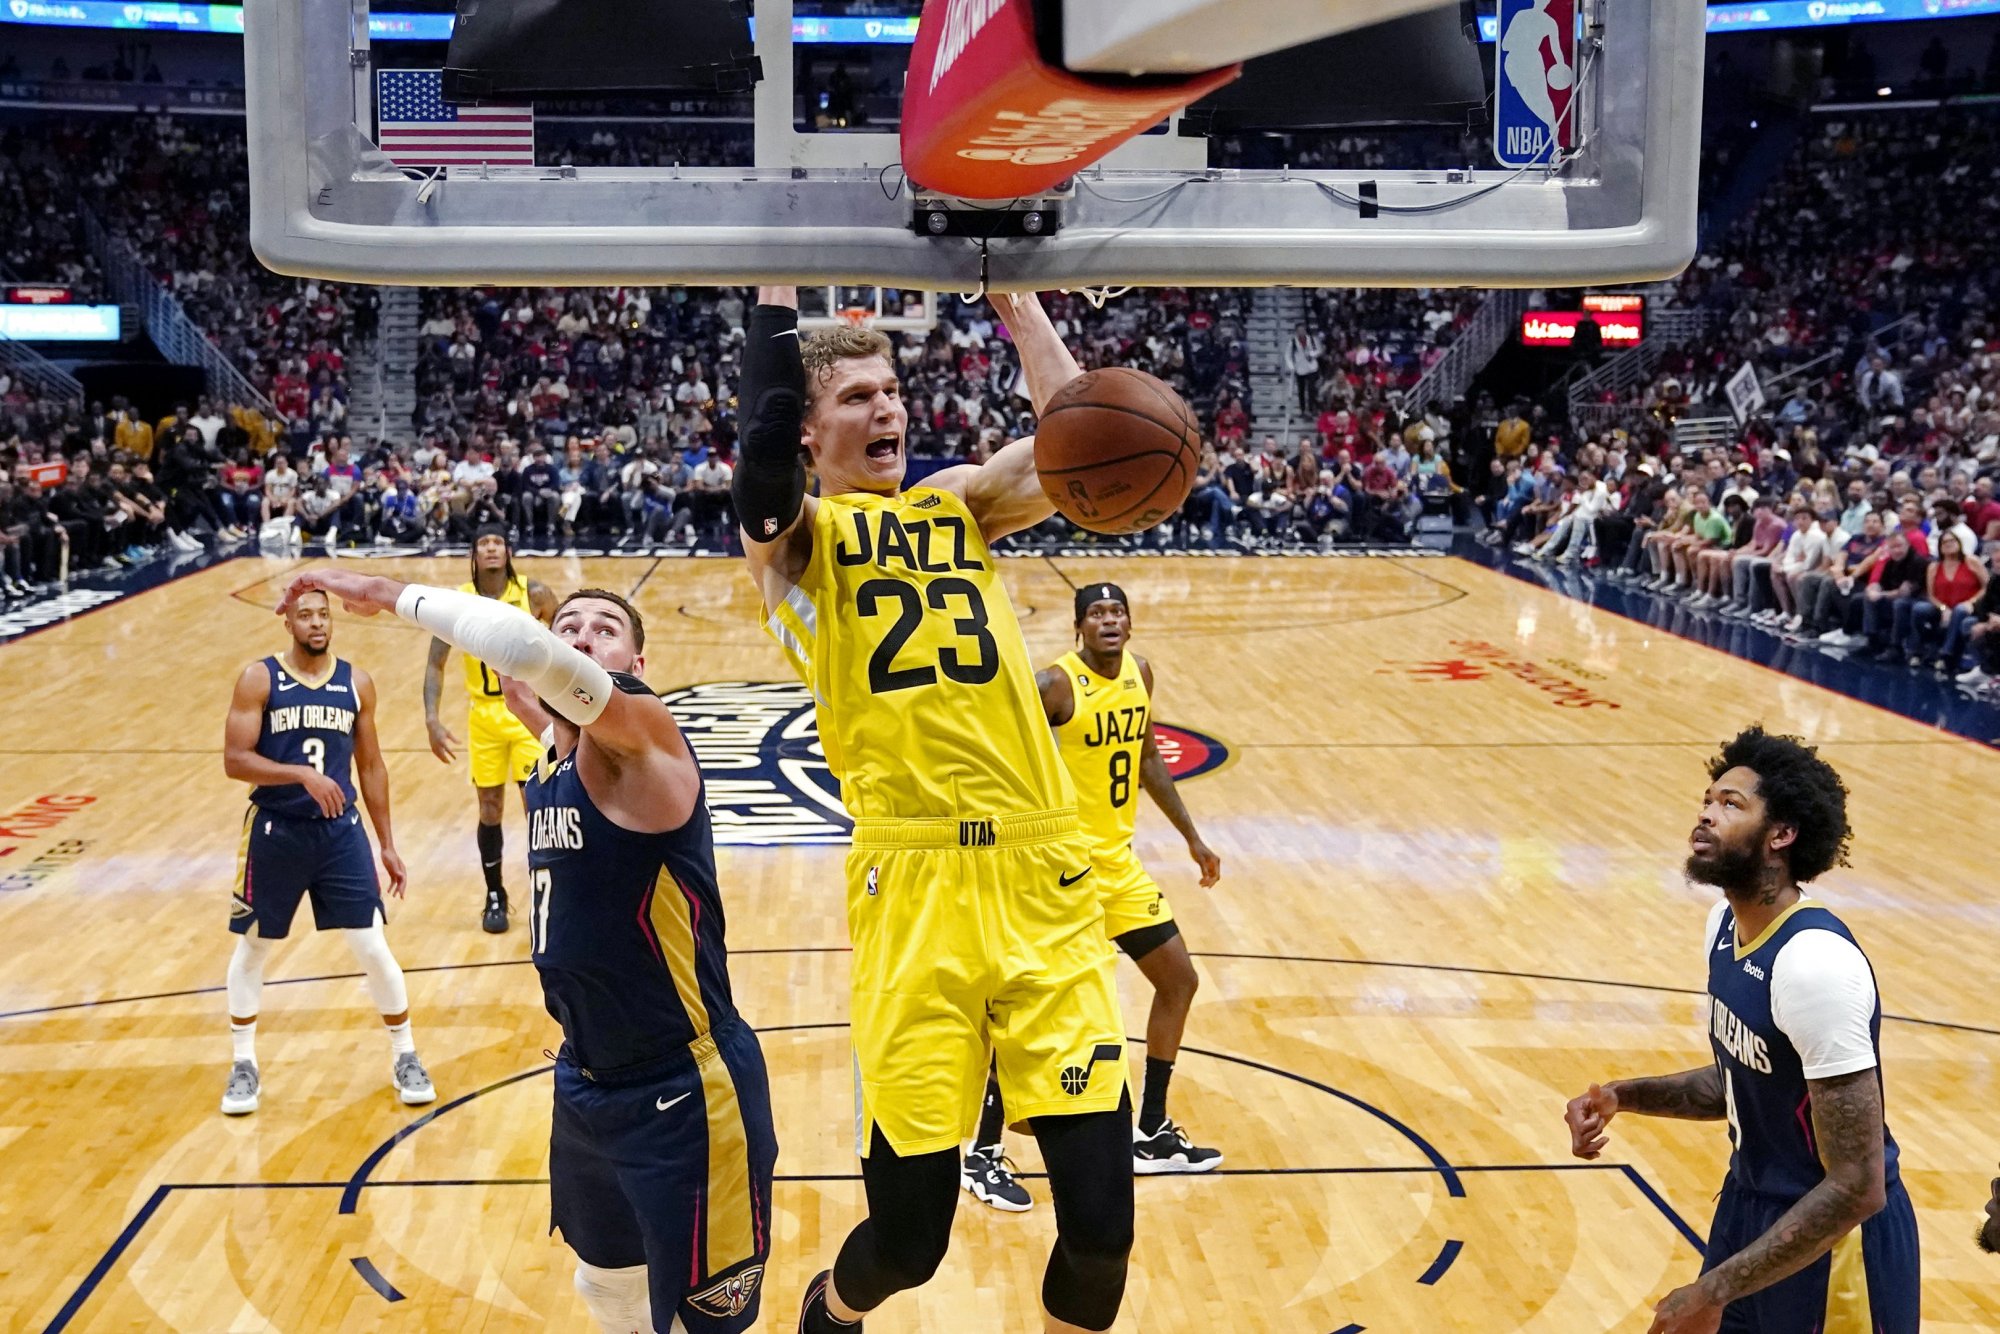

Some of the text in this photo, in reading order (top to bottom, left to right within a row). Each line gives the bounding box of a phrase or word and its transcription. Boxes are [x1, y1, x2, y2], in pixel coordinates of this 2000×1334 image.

[1507, 127, 1543, 155] NBA
[837, 510, 985, 573] JAZZ
[856, 577, 999, 695] 23
[270, 705, 355, 735] NEW ORLEANS
[1085, 705, 1145, 747] JAZZ
[302, 737, 325, 775] 3
[1109, 750, 1131, 808] 8
[960, 821, 995, 846] UTAH
[1743, 958, 1765, 981] ibotta
[1714, 998, 1772, 1074] ORLEANS
